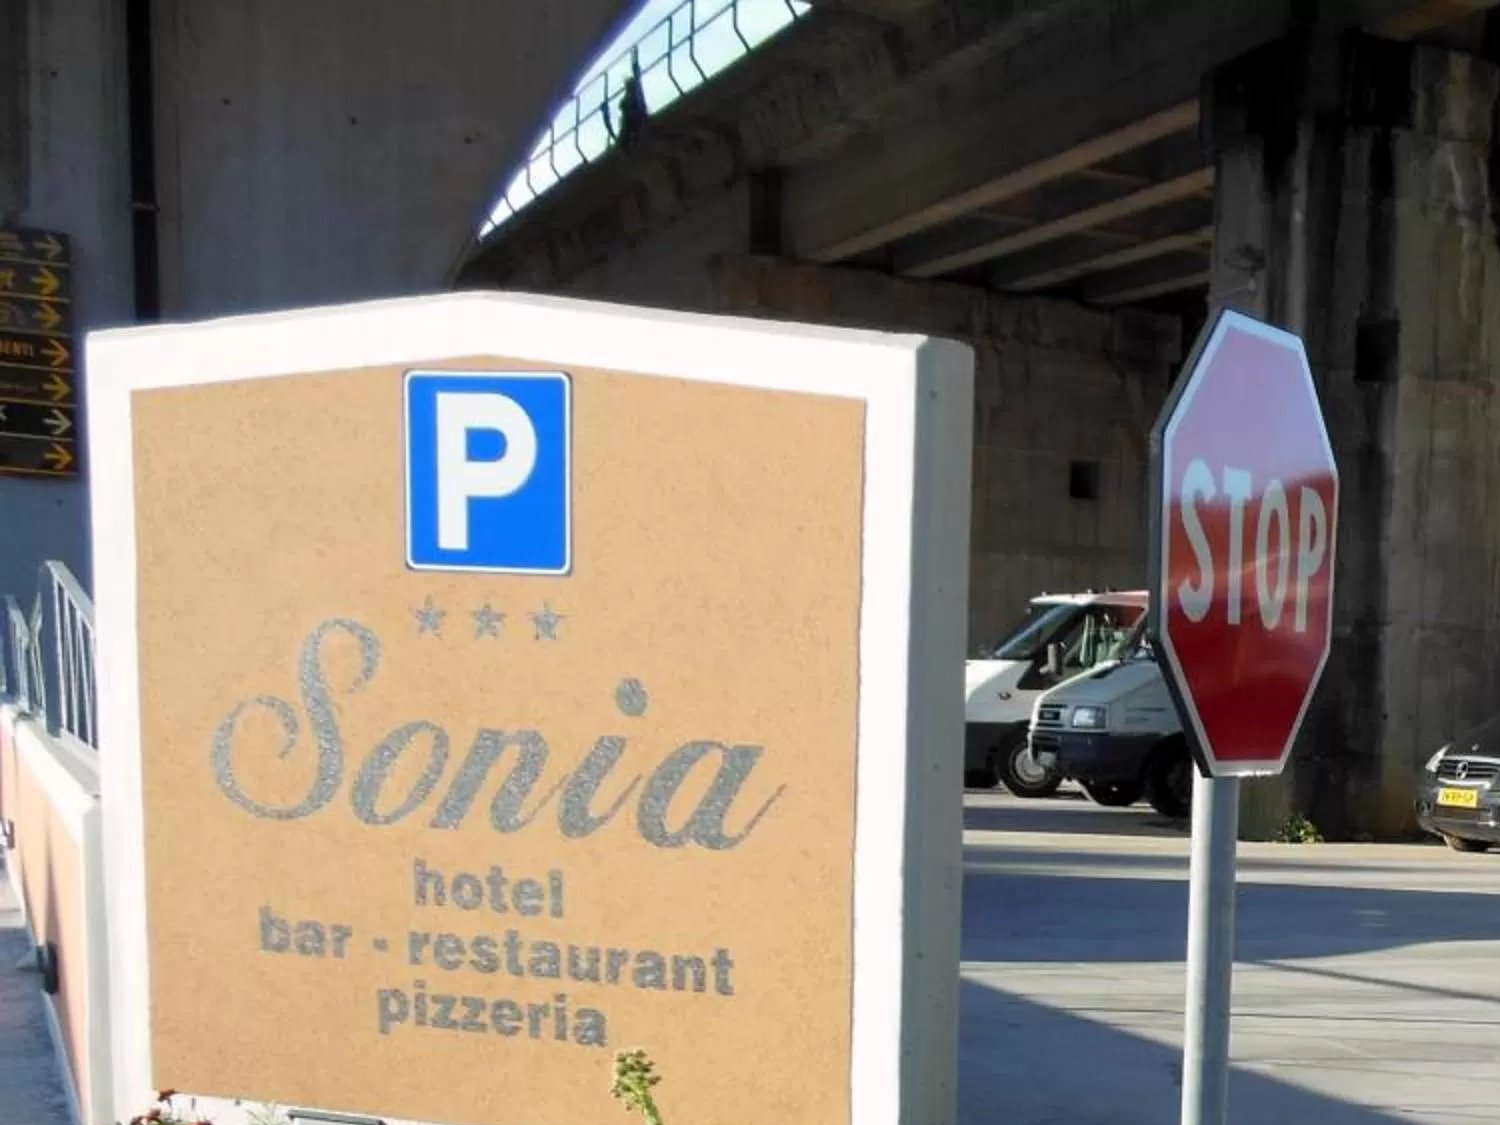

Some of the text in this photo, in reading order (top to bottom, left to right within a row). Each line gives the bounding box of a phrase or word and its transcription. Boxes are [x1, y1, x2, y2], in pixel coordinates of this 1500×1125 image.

[437, 391, 538, 551] P
[1178, 458, 1327, 632] STOP
[211, 618, 787, 849] Sonia
[413, 860, 564, 918] hotel
[259, 909, 353, 956] bar
[409, 929, 736, 996] restaurant
[376, 981, 607, 1047] pizzeria
